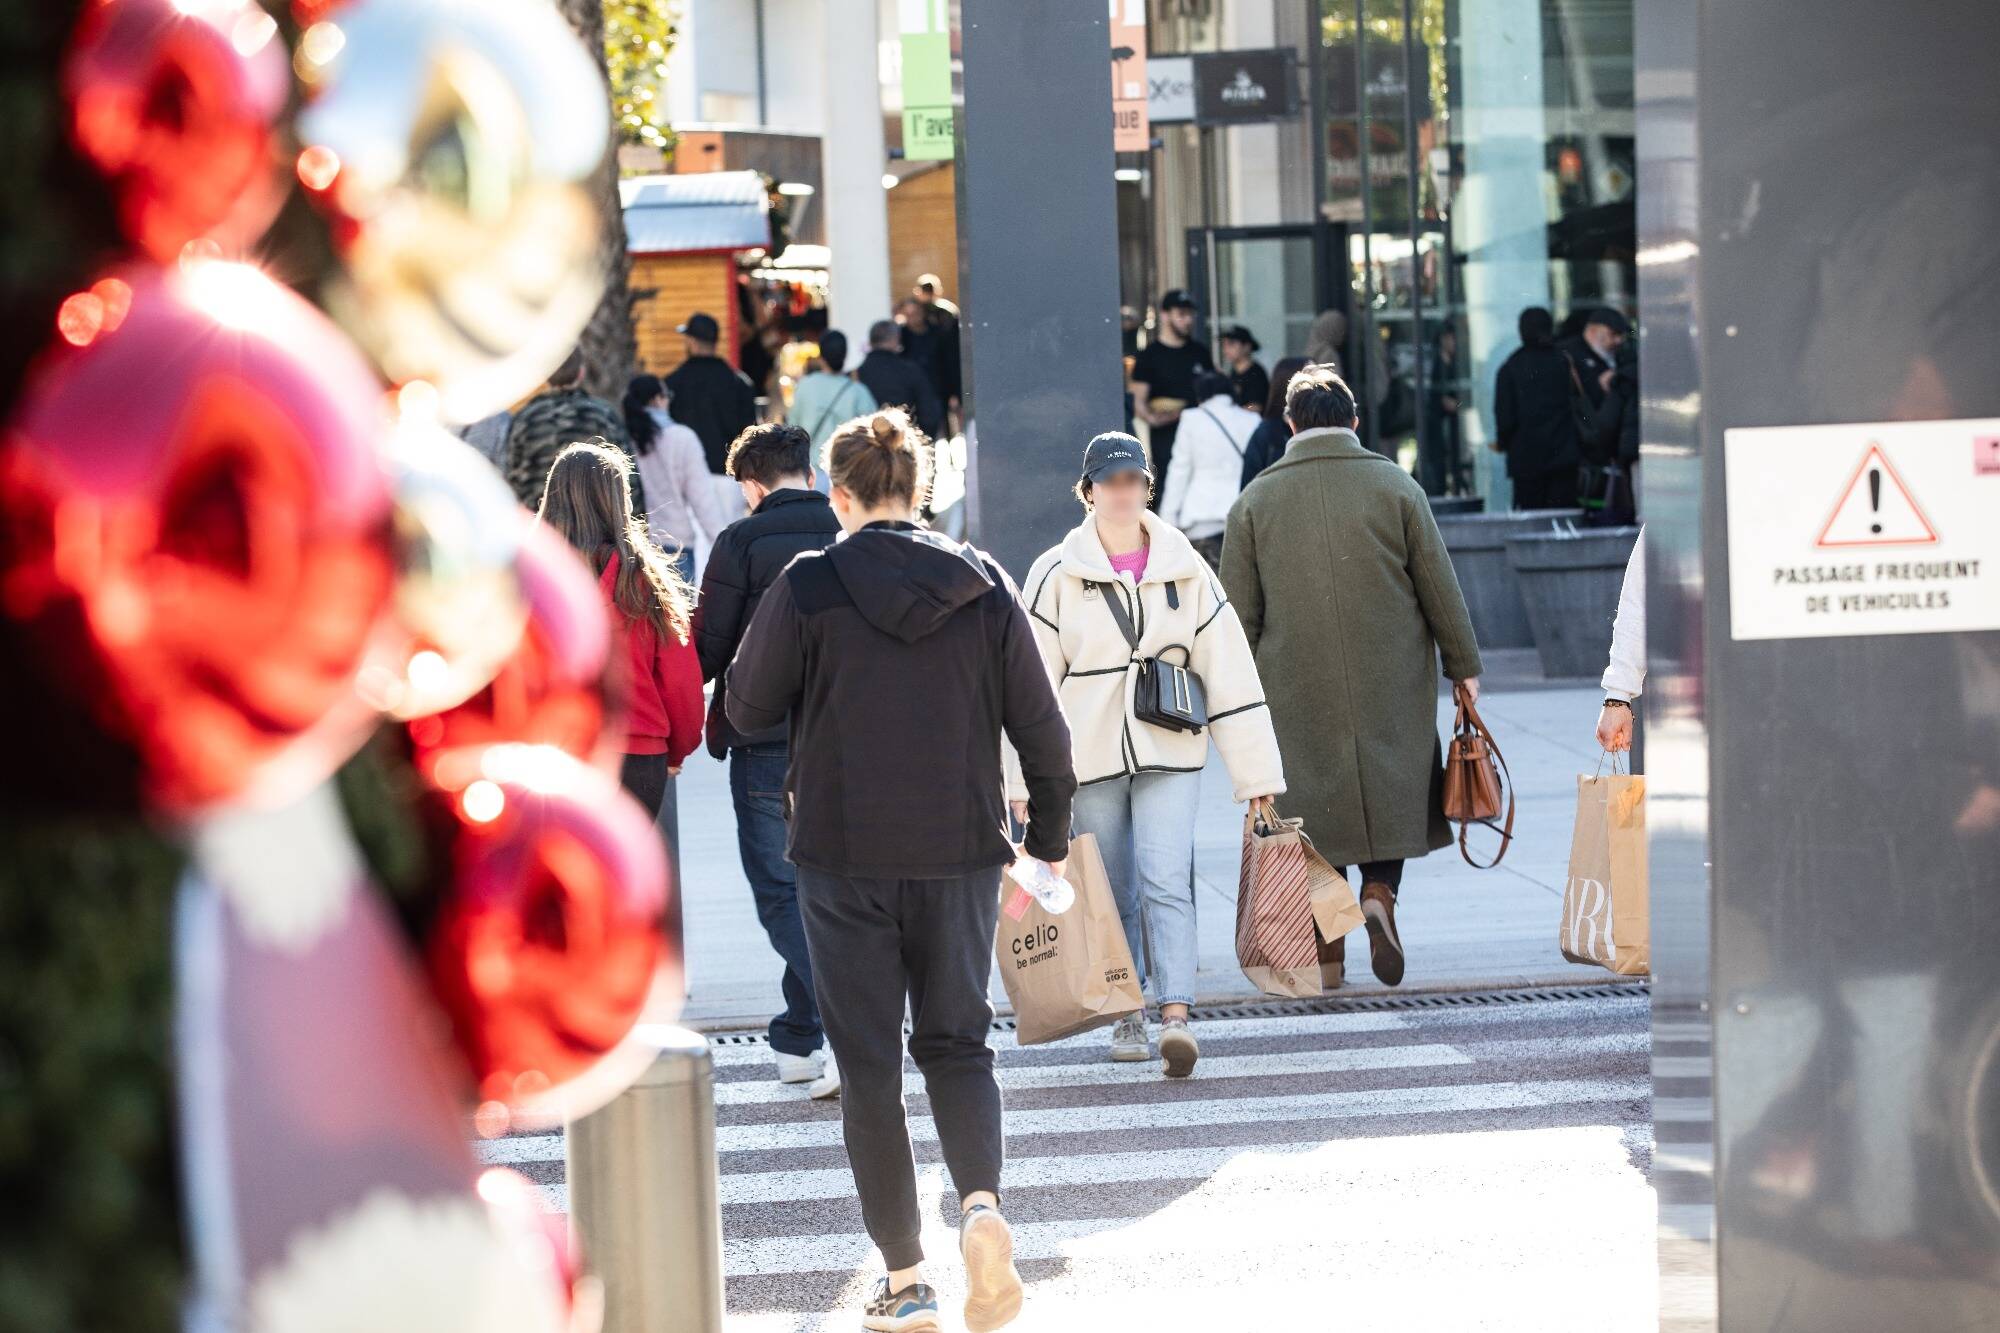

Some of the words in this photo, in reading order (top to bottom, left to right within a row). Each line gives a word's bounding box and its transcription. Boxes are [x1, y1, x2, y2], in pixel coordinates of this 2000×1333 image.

[912, 113, 953, 137] l'ave
[1773, 563, 1865, 585] PASSAGE
[1876, 560, 1980, 581] FREQUENT
[1806, 596, 1829, 613] DE
[1840, 591, 1950, 612] VEHICULES
[1561, 874, 1616, 961] ARA
[1012, 923, 1058, 955] celio
[1016, 958, 1028, 969] be
